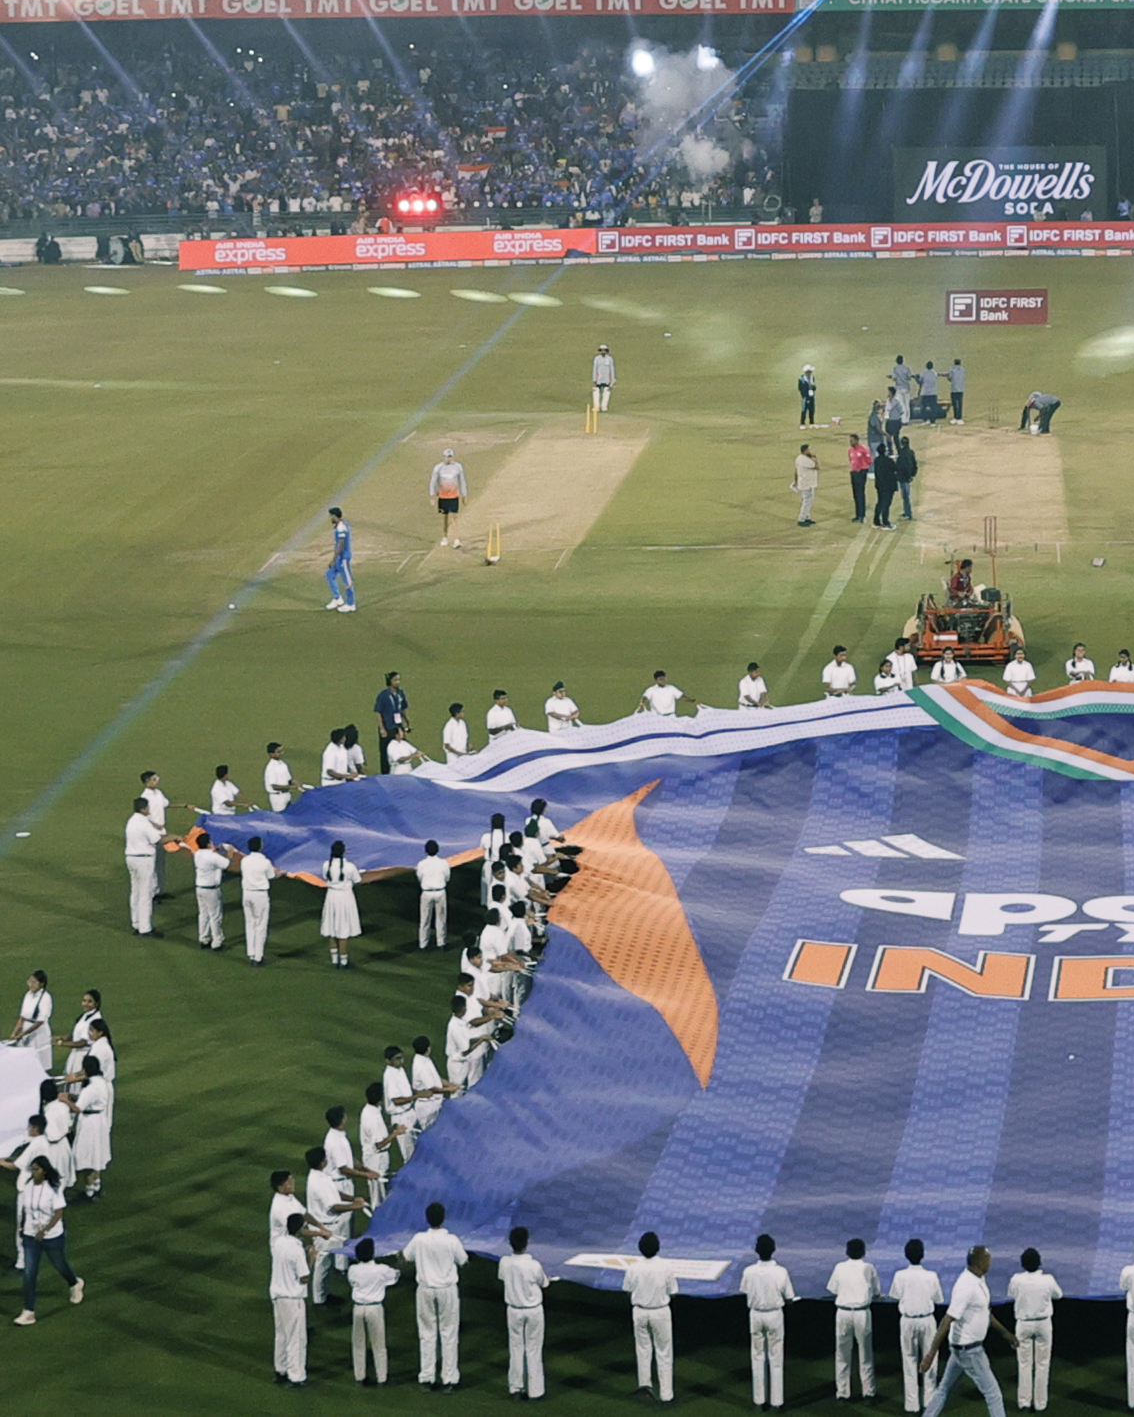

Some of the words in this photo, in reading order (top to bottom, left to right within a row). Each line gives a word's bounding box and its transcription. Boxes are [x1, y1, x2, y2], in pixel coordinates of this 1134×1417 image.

[906, 159, 1095, 204] McDowell's
[620, 235, 651, 248] IDFC
[655, 234, 694, 247] FIRST
[697, 234, 730, 247] Bank
[757, 233, 788, 246] IDFC
[792, 232, 830, 245] FIRST
[833, 231, 866, 244] Bank
[893, 231, 924, 243] IDFC
[928, 231, 967, 243] FIRST
[969, 230, 1002, 243] Bank
[1029, 230, 1060, 242] IDFC
[1064, 230, 1102, 242] FIRST
[355, 243, 426, 259] express
[493, 239, 563, 255] express
[214, 249, 287, 264] express
[980, 297, 1008, 308] IDFC
[1010, 297, 1044, 308] FIRST
[980, 310, 1009, 321] Bank
